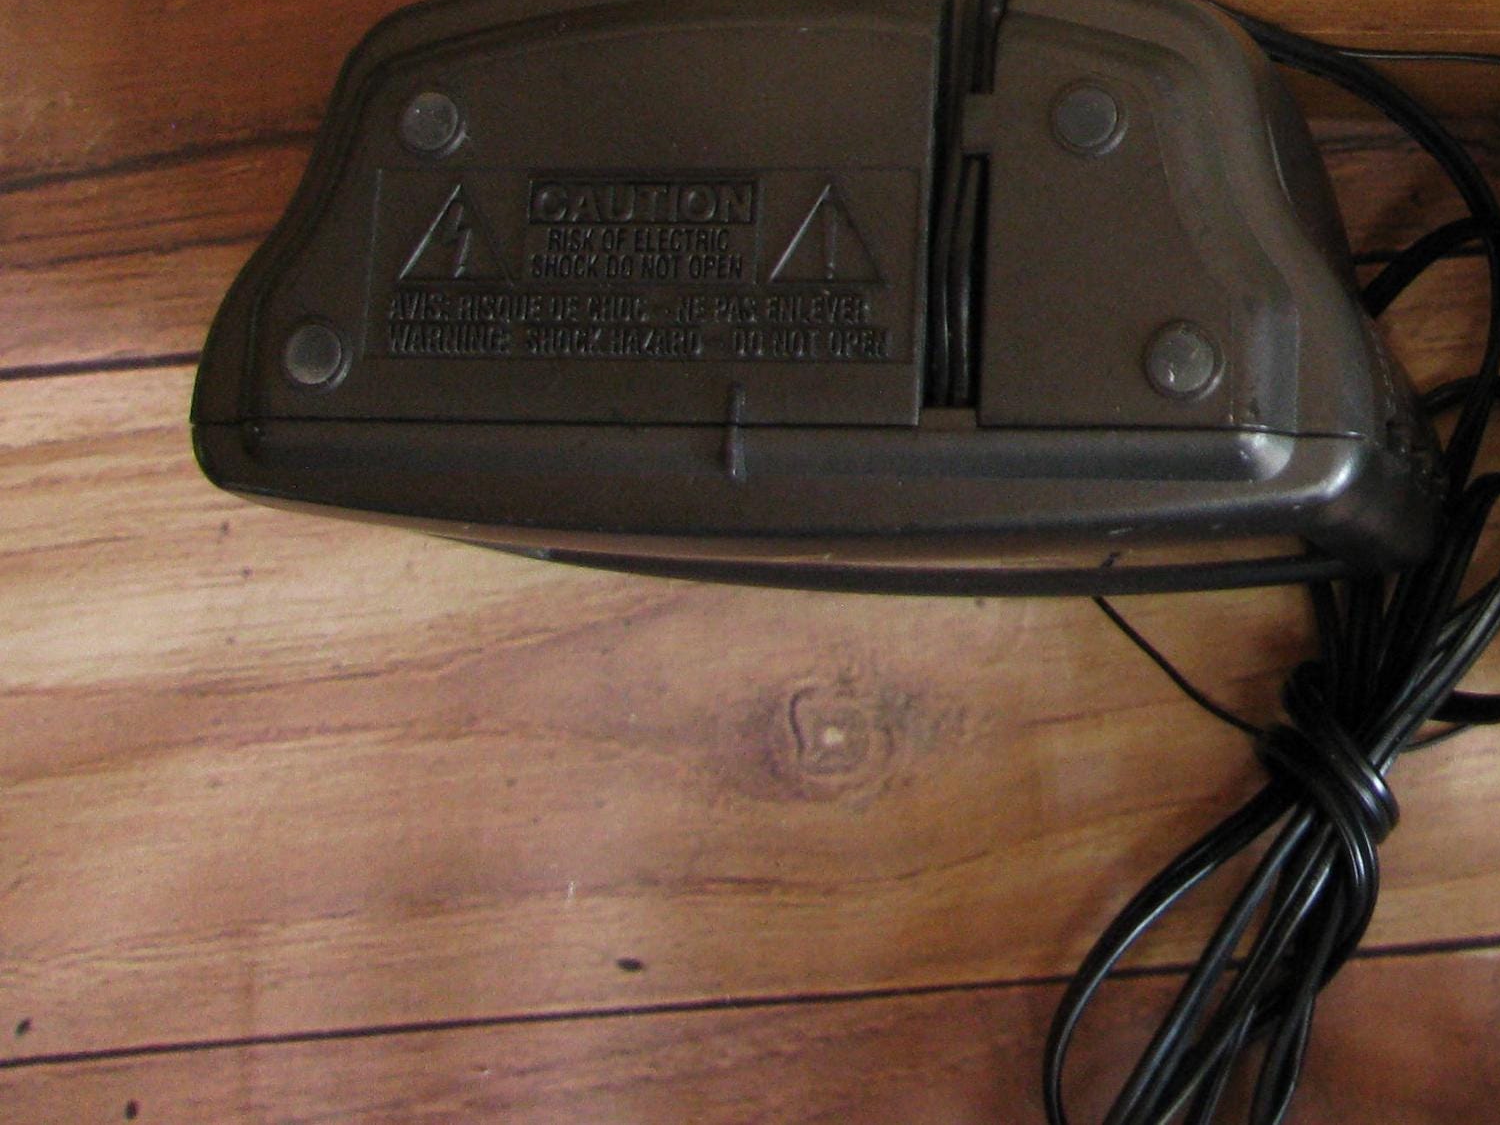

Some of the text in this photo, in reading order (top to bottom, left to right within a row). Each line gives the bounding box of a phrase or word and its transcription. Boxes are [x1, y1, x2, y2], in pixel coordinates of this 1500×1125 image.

[534, 183, 753, 223] CAUTION
[548, 227, 730, 253] RISK OF ELECTRIC
[530, 253, 743, 279] SHOCK DO NOT OPEN
